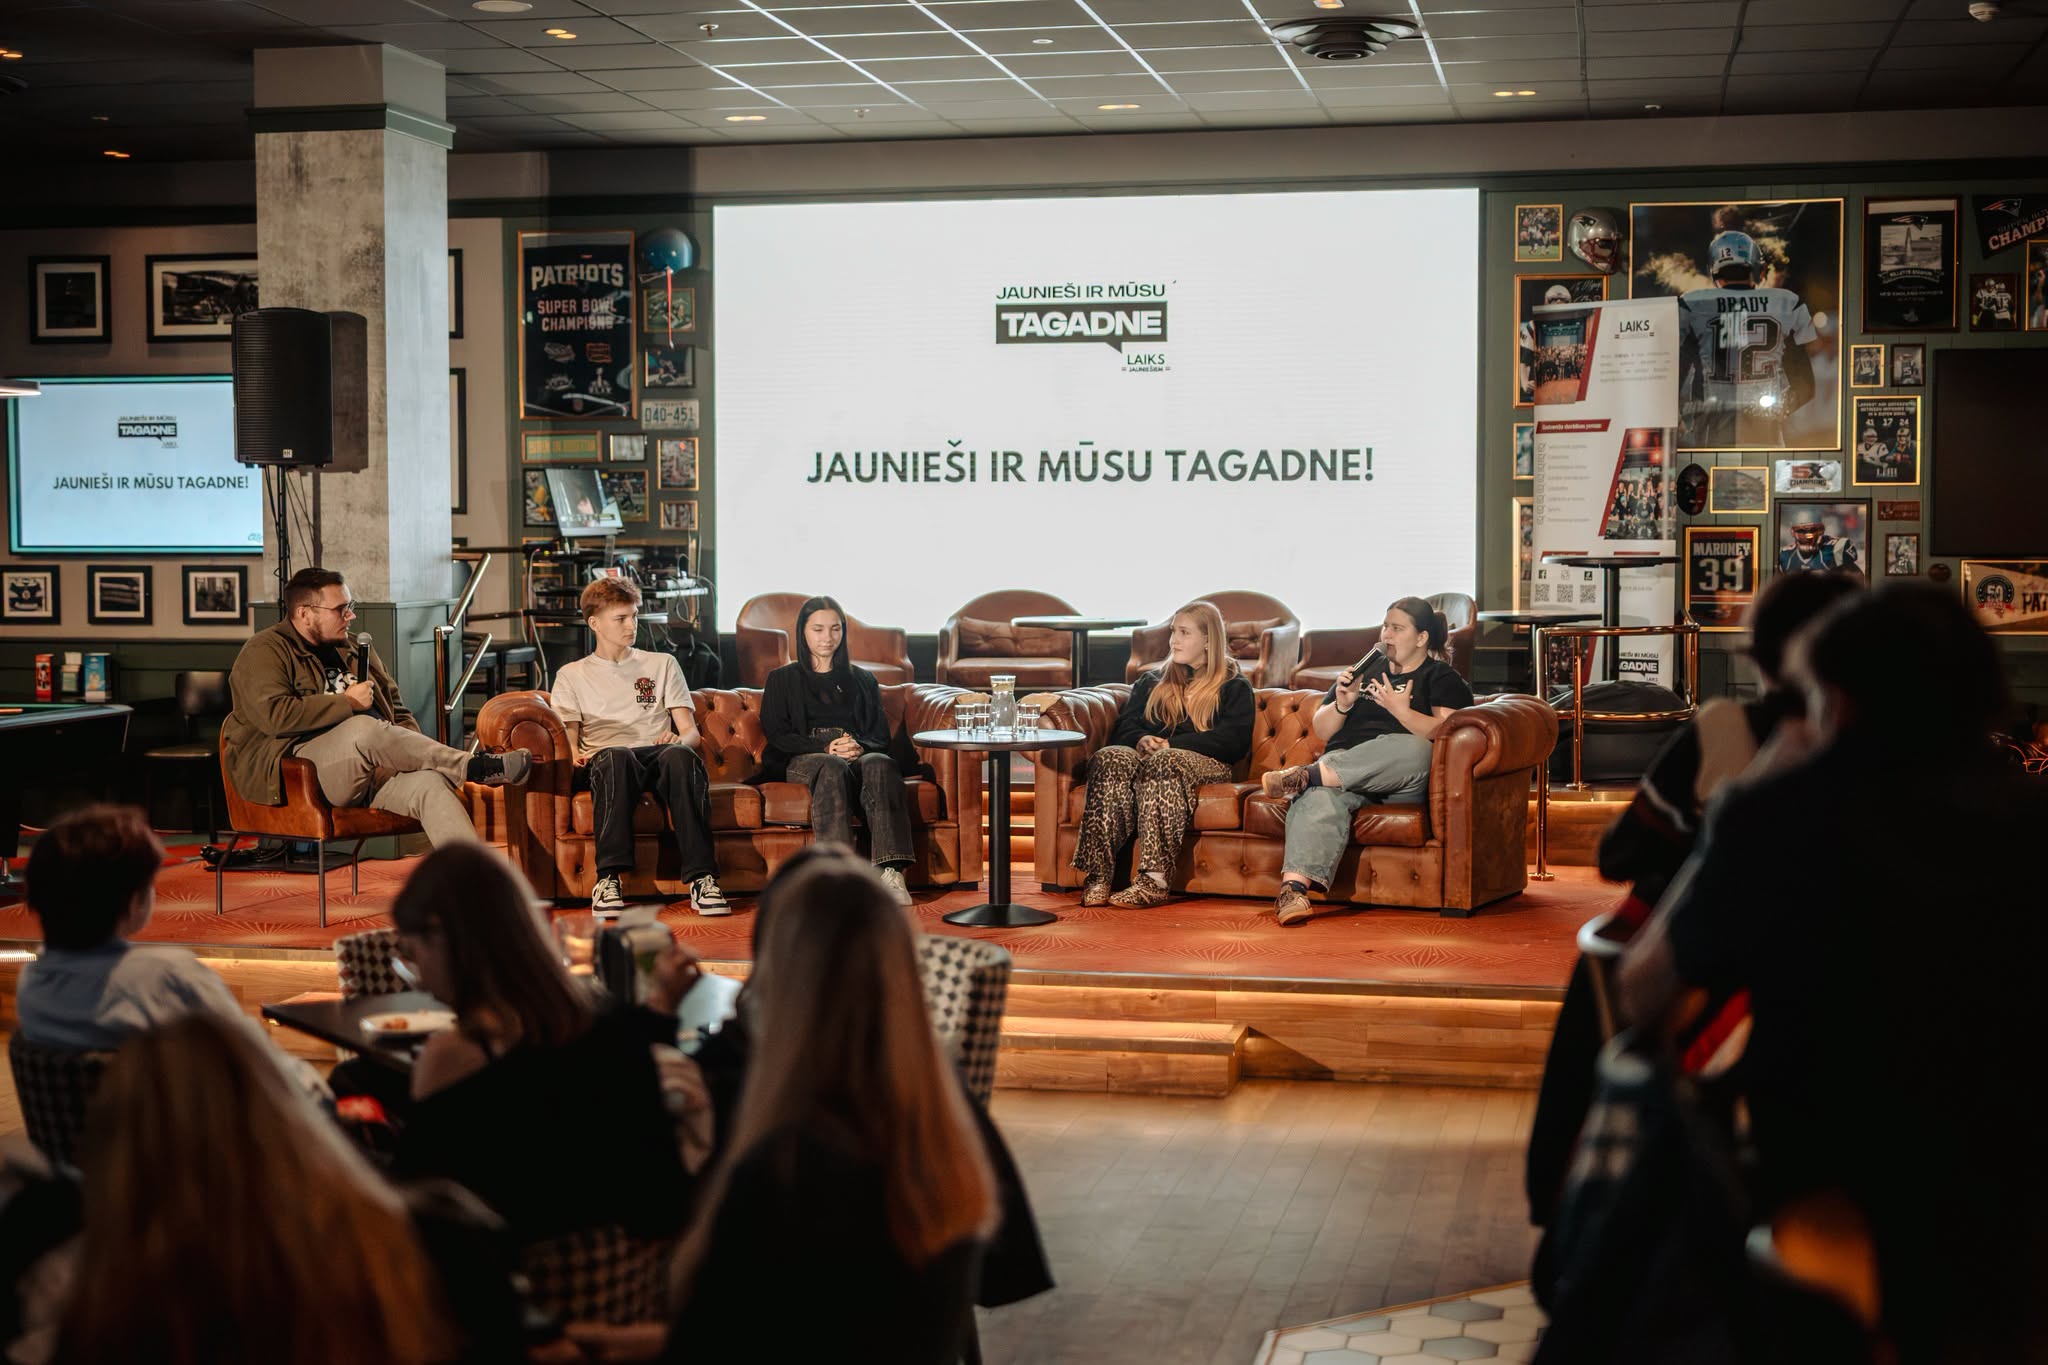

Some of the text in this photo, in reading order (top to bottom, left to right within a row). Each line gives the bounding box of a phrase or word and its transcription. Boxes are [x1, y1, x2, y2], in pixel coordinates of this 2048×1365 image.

[1720, 248, 1732, 258] 12
[531, 263, 624, 291] PATRIOTS
[996, 282, 1166, 299] JAUNIEŠI IR MŪSU
[537, 298, 617, 315] SUPER BOWL
[1717, 297, 1769, 313] BRADY
[541, 316, 614, 332] CHAMPIONS
[1001, 310, 1162, 337] TAGADNE
[1619, 320, 1650, 333] LAIKS
[1707, 315, 1782, 385] 12
[1127, 353, 1166, 365] LAIKS
[1882, 418, 1894, 426] 17
[120, 425, 176, 436] TAGADNE
[806, 440, 1374, 483] JAUNIEŠI IR MŪSU TAGADNE!
[1791, 463, 1825, 478] 5X
[53, 473, 249, 489] JAUNIEŠI IR MŪSU TAGADNE!
[1693, 542, 1752, 557] MARONEY
[1699, 558, 1745, 592] 39
[1619, 660, 1658, 672] GADNE
